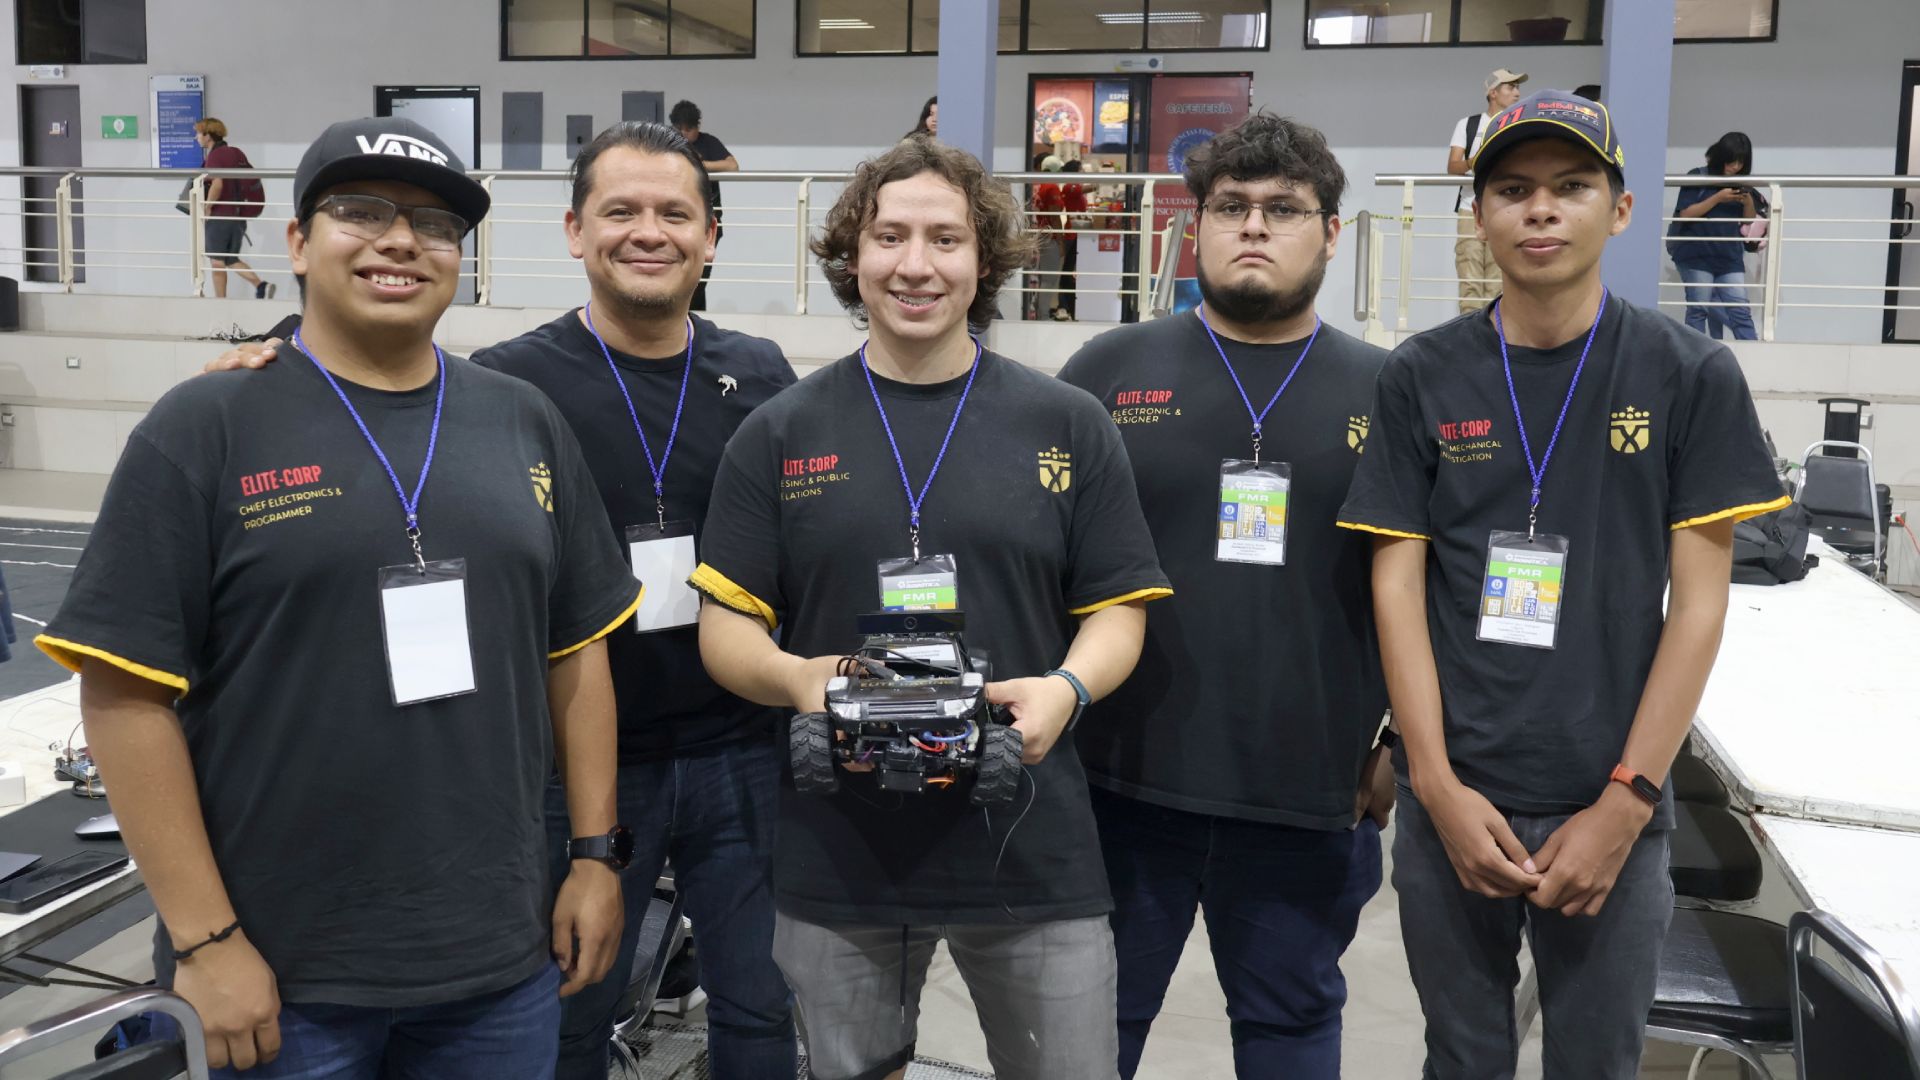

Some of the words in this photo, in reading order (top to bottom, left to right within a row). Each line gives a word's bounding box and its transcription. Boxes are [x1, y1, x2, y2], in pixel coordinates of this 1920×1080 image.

[1498, 104, 1526, 129] 11
[1537, 111, 1599, 126] RACING
[1155, 197, 1191, 205] ACULTAD
[1116, 390, 1173, 405] ELITE-CORP
[1112, 407, 1171, 418] ELECTRONIC
[1174, 408, 1182, 416] &
[1449, 440, 1502, 452] MECHANICAL
[783, 454, 838, 476] LITE-CORP
[240, 465, 322, 496] ELITE-CORP
[780, 477, 806, 488] ESING
[808, 476, 814, 485] &
[816, 472, 850, 483] PUBLIC
[240, 500, 268, 516] CHIEF
[268, 488, 334, 508] ELECTRONICS
[335, 487, 343, 496] &
[1238, 493, 1269, 502] FMR
[244, 505, 312, 531] PROGRAMMER
[1508, 567, 1542, 577] FMR
[903, 592, 937, 602] FMR
